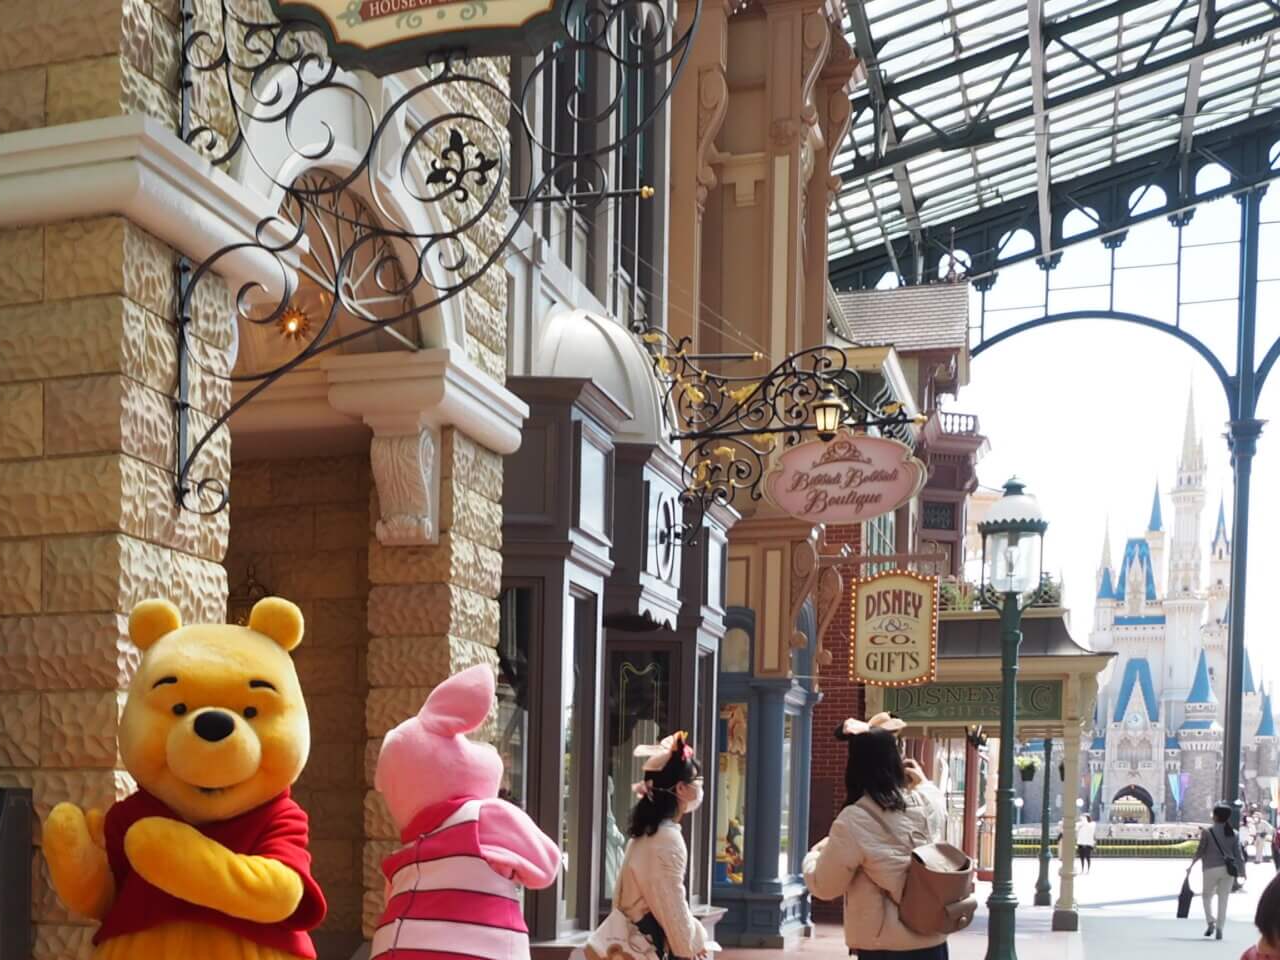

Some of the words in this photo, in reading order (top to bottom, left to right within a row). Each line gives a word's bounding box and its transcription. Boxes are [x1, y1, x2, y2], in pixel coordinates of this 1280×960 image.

[370, 0, 417, 16] HOUSE
[801, 485, 883, 515] Boutique
[865, 589, 923, 621] DISNEY
[869, 633, 916, 646] CO.
[865, 650, 920, 673] GIFTS
[893, 685, 1001, 714] DISNEY
